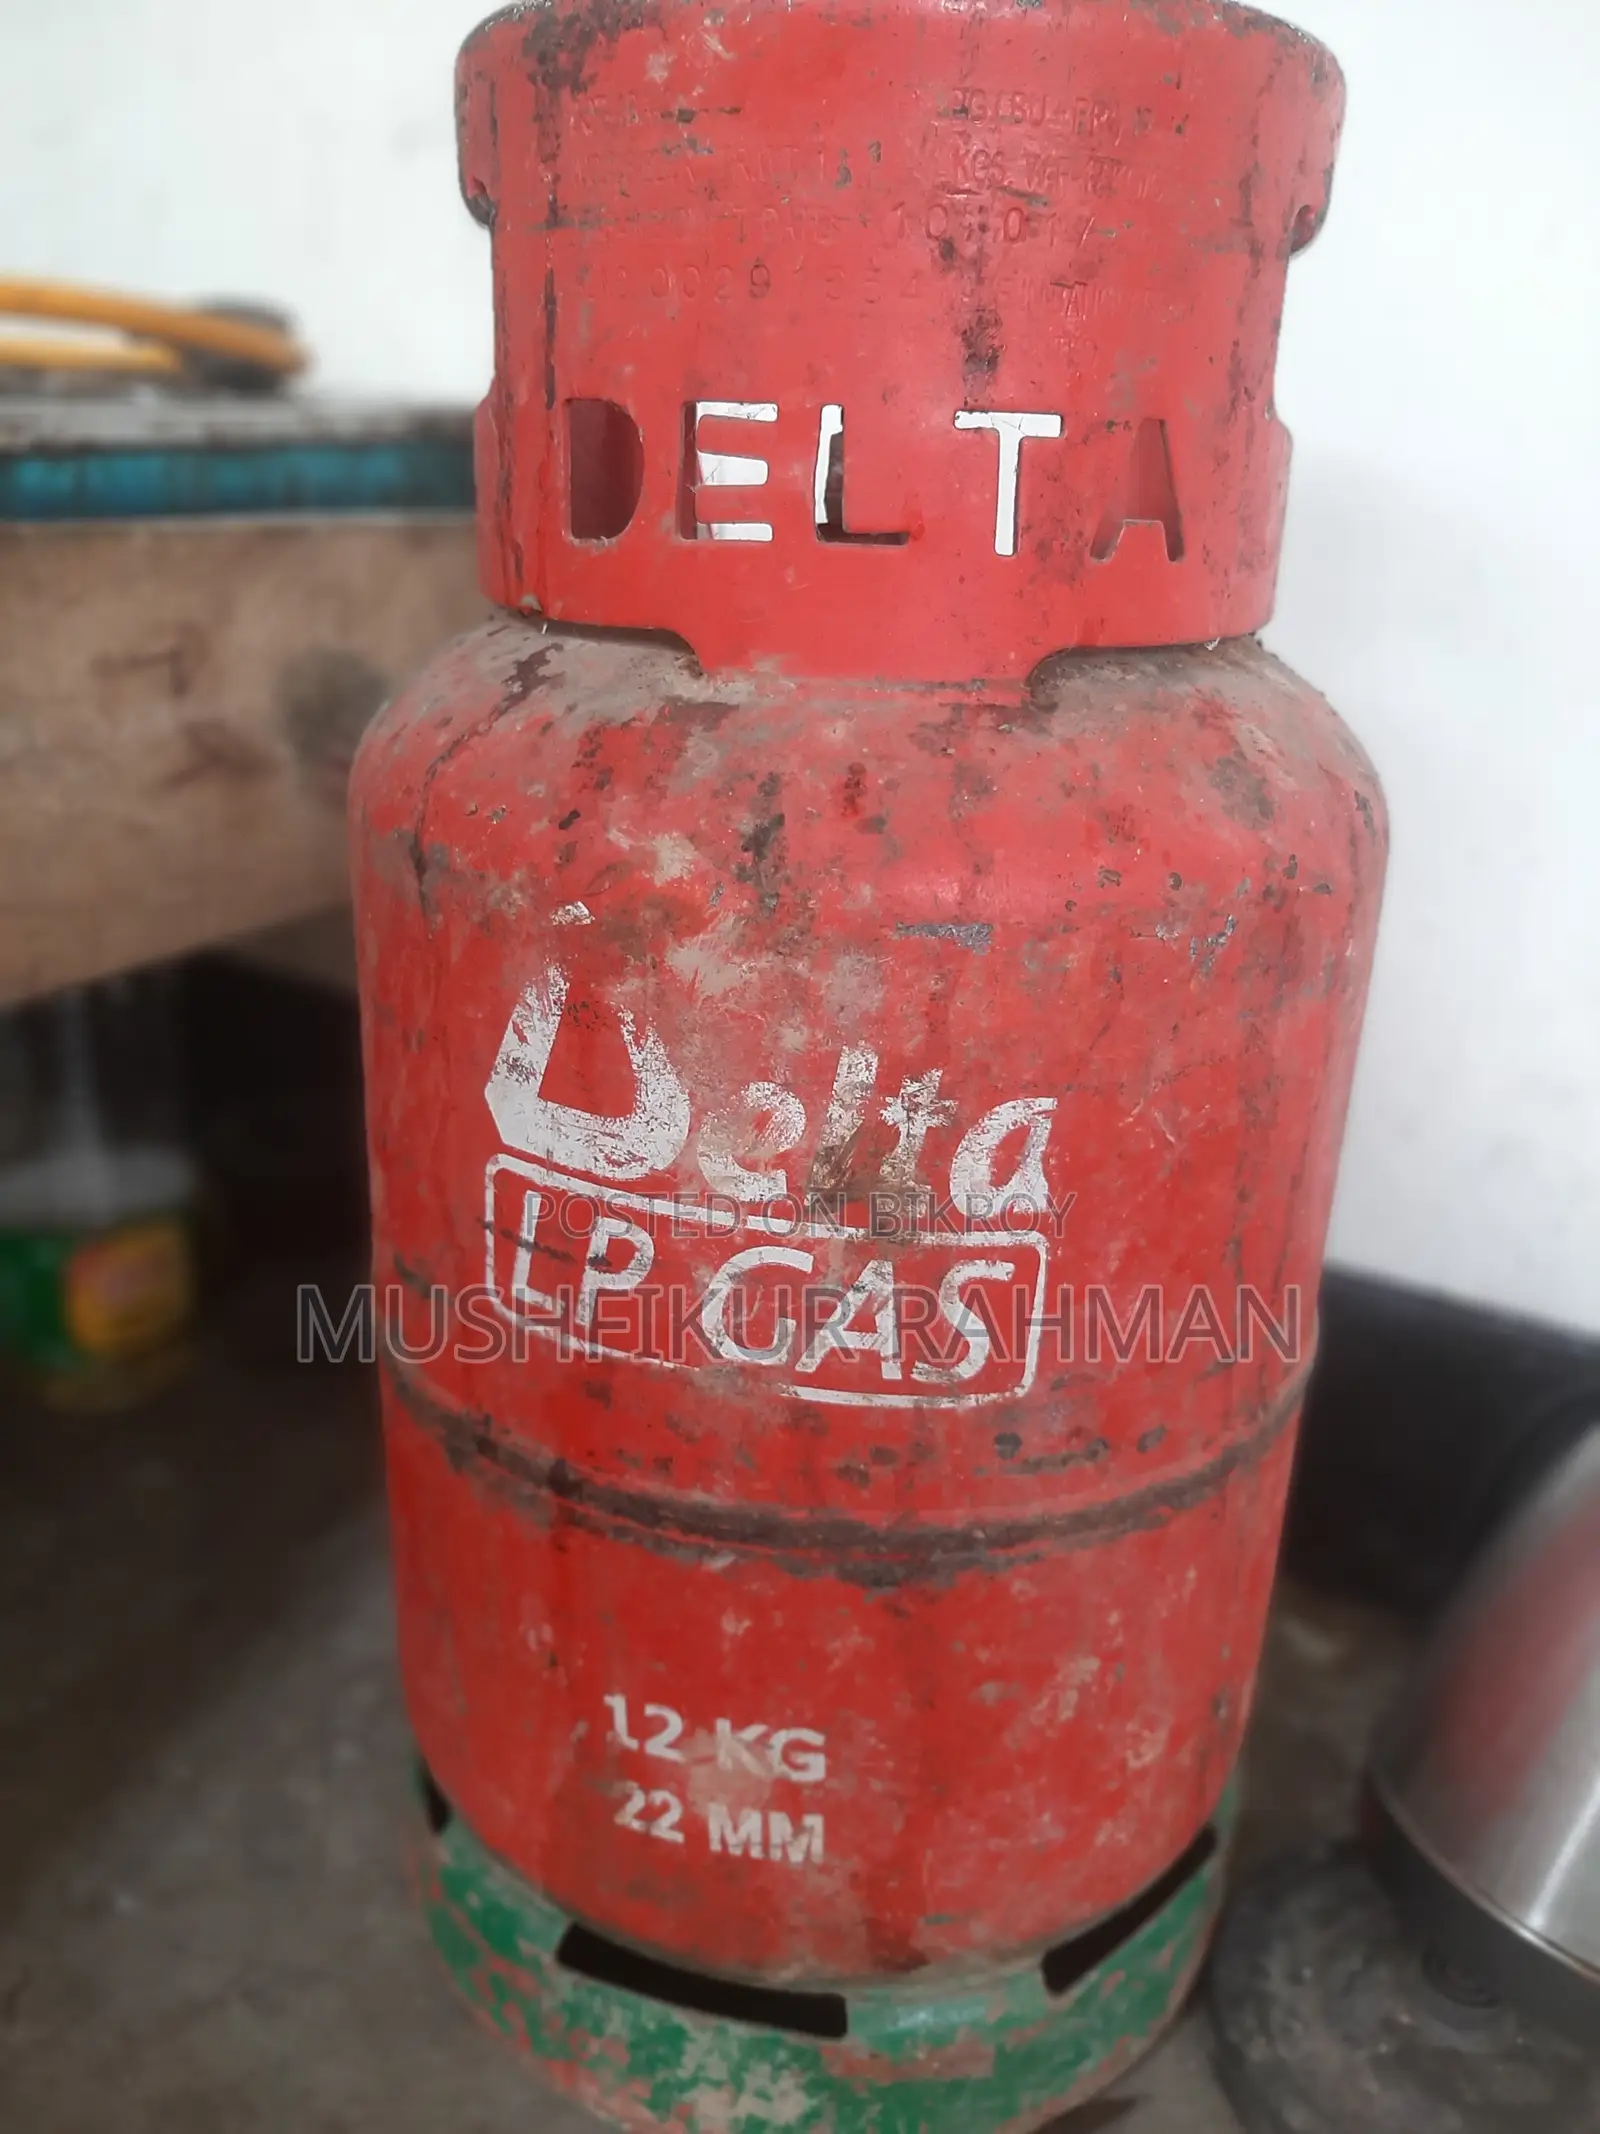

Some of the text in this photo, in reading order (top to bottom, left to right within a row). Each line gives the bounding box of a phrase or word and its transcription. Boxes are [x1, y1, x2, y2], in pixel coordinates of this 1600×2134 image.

[567, 396, 1186, 562] DELTA
[512, 1190, 1016, 1383] LP GAS
[604, 1692, 827, 1783] 12 KG
[614, 1779, 825, 1865] 22 MM
